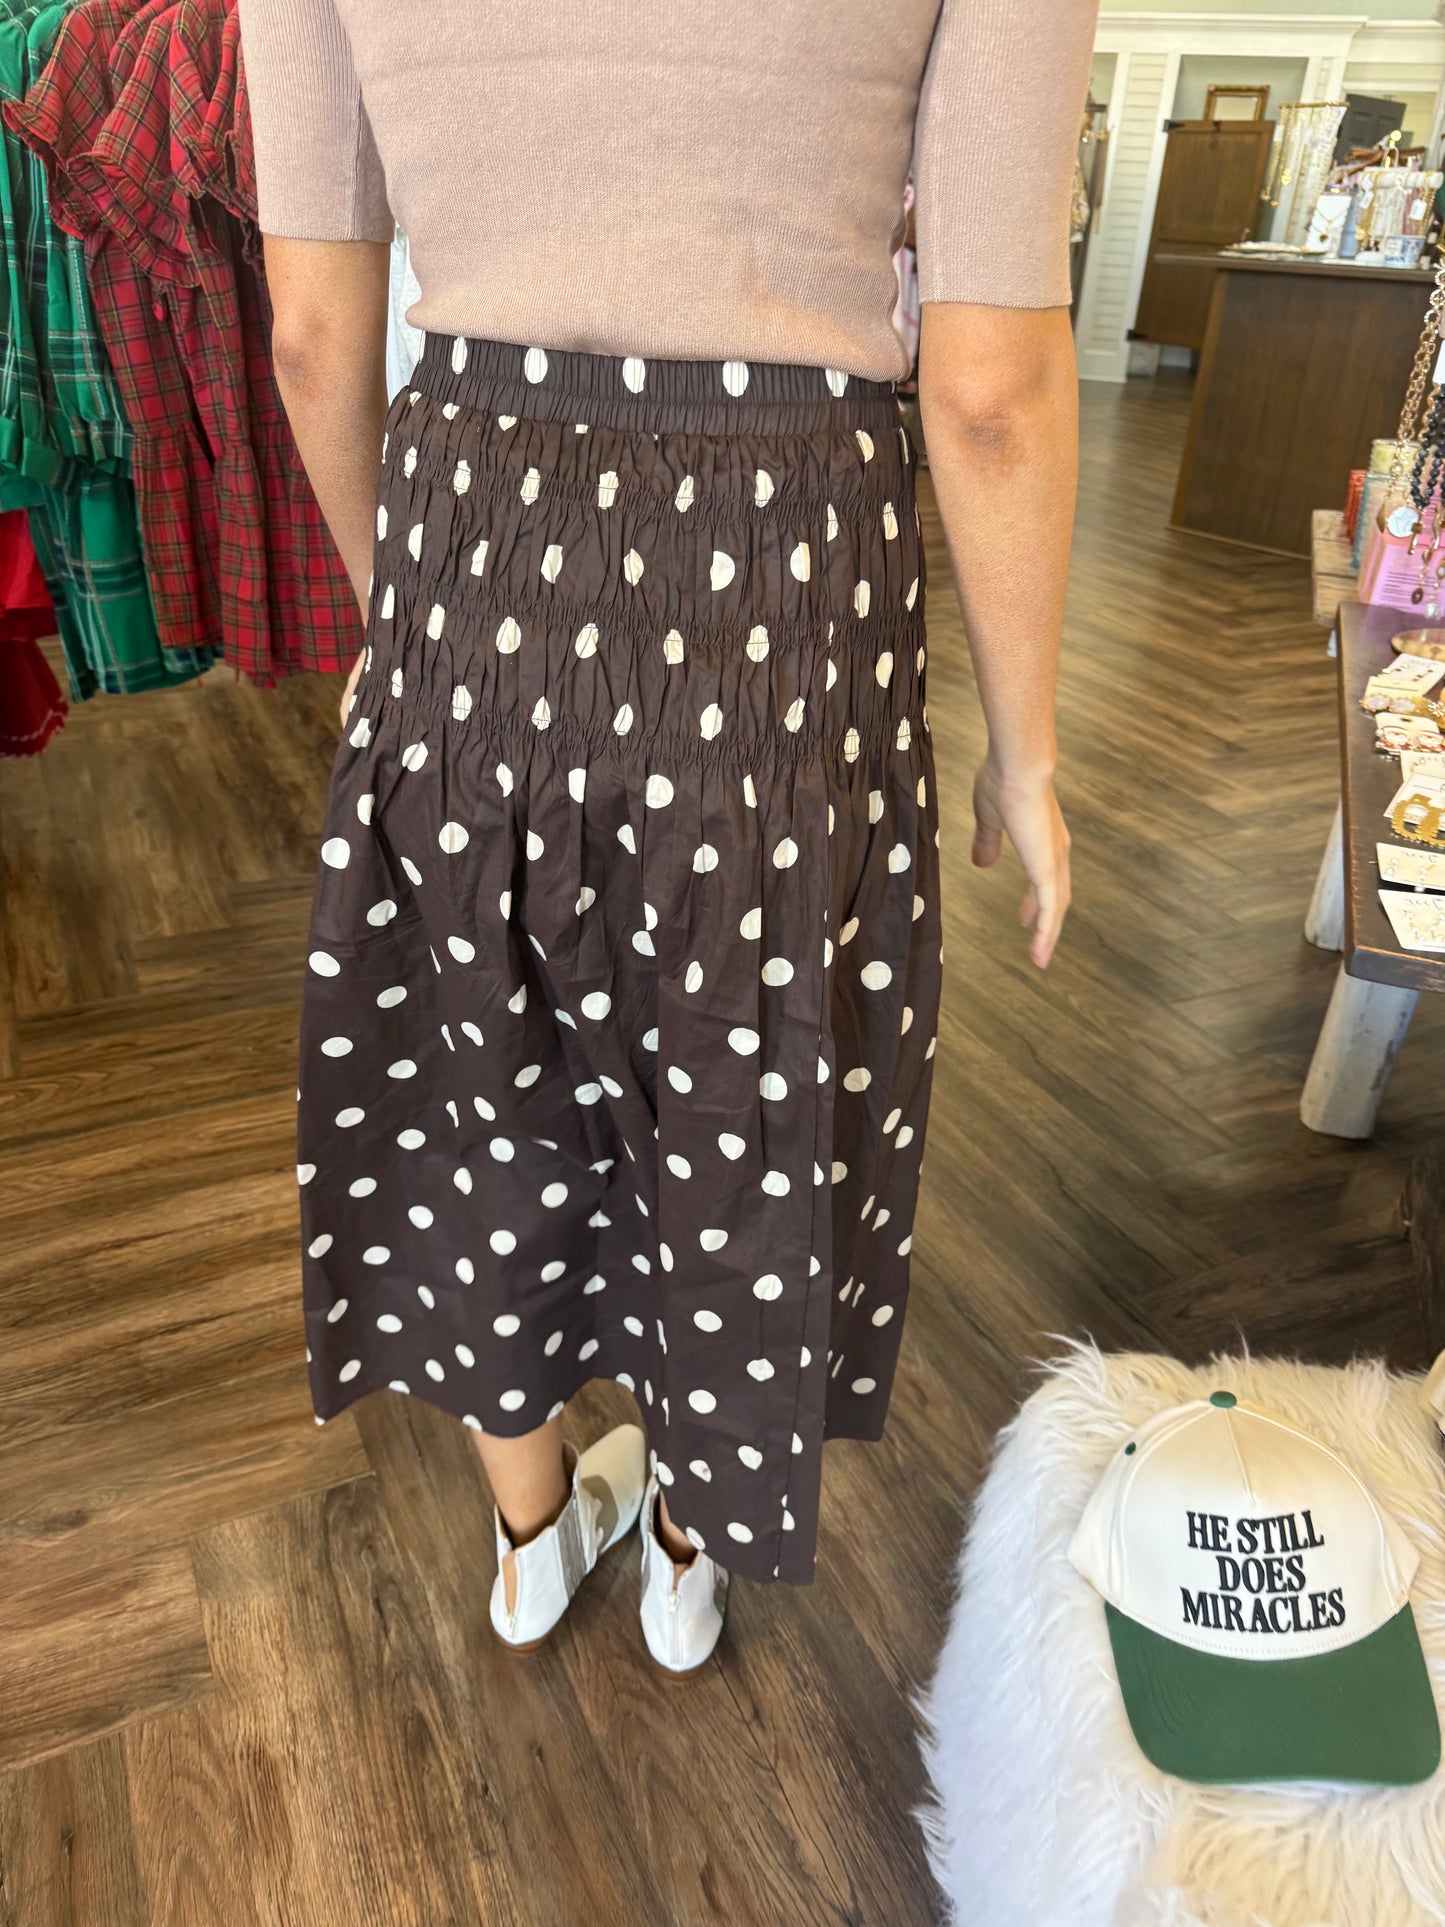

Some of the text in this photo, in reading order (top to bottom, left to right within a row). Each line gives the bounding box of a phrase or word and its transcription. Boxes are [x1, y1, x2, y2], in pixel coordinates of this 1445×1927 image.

[1186, 1509, 1325, 1555] HE STILL
[1216, 1554, 1307, 1594] DOES
[1180, 1587, 1346, 1634] MIRACLES
